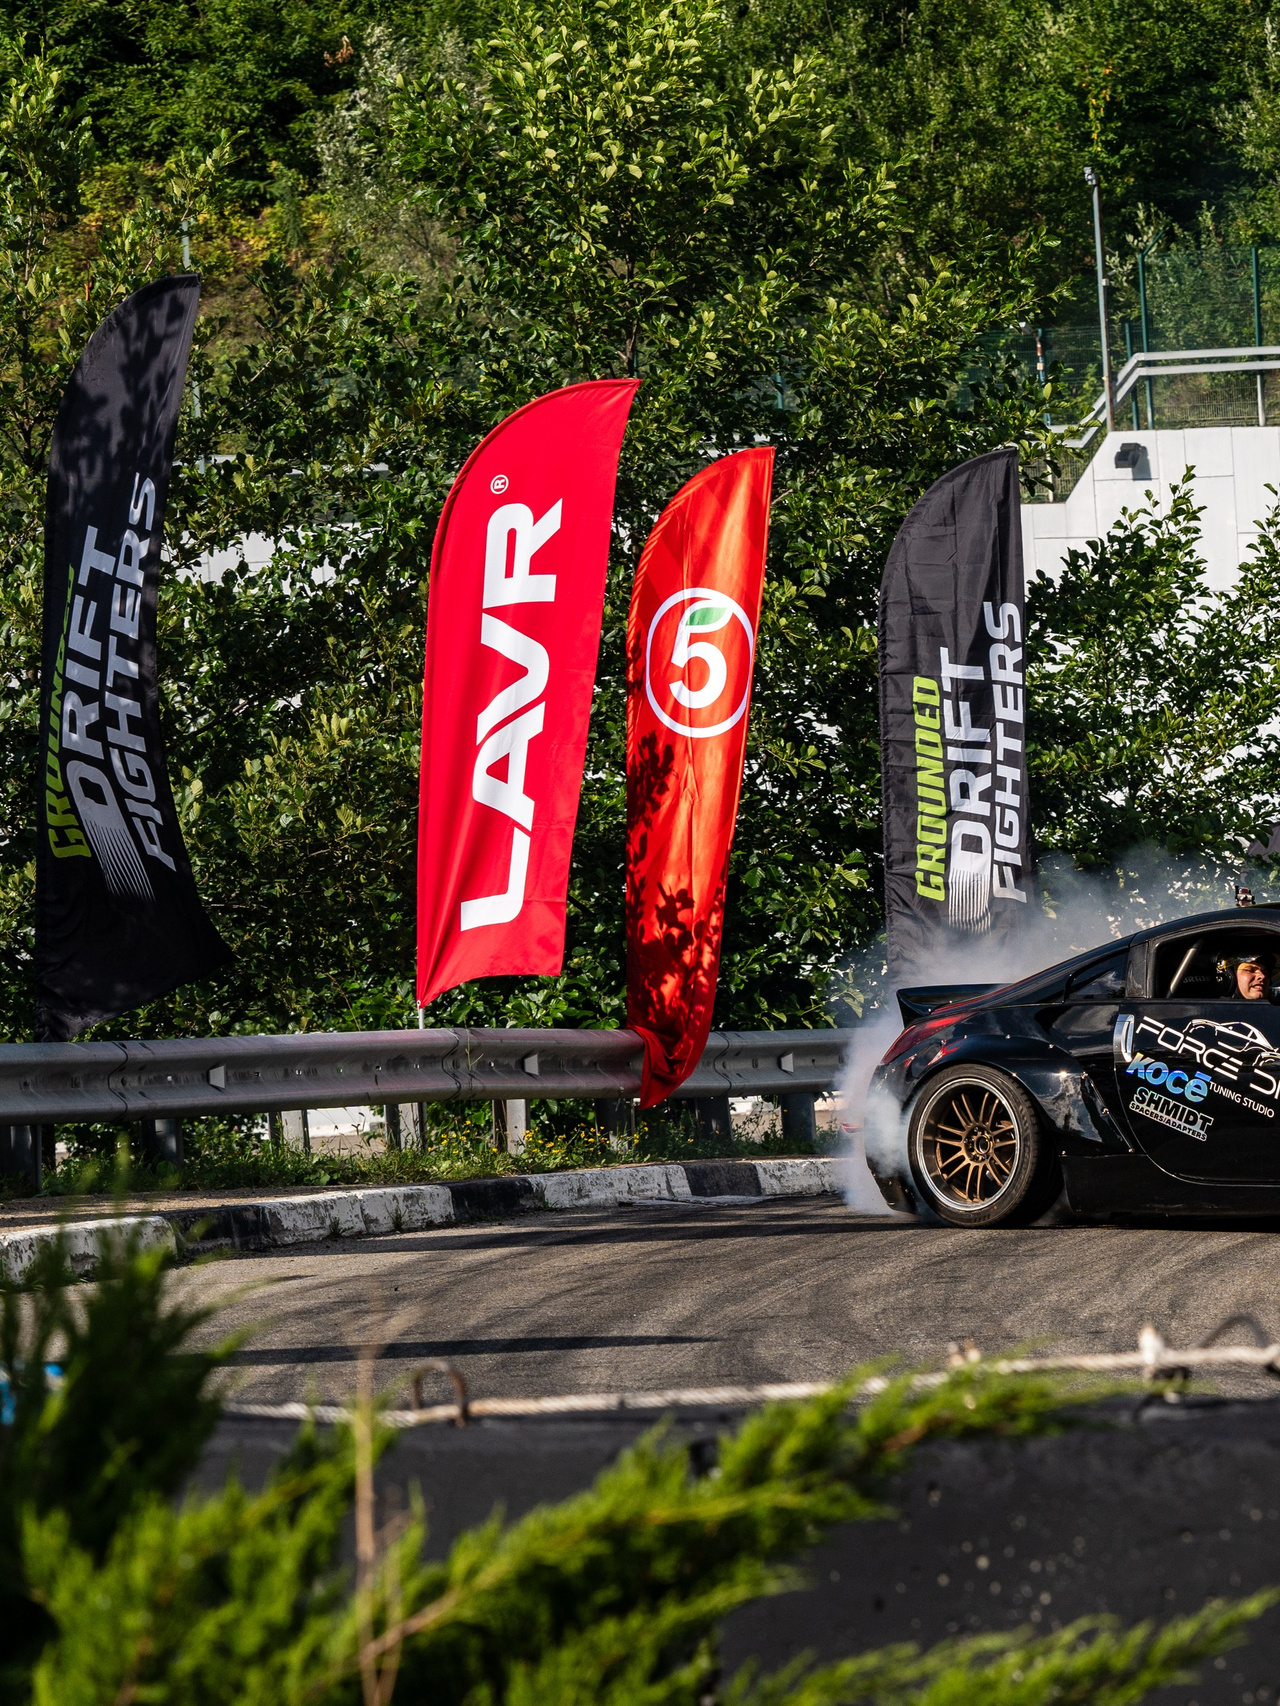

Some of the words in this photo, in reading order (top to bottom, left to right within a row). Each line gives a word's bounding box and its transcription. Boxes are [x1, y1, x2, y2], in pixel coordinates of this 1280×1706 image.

[46, 563, 92, 858] GROUND
[66, 526, 128, 860] DRIFT
[105, 472, 176, 872] FIGHTERS
[460, 498, 562, 932] LAVR
[912, 676, 947, 901] GROUNDED
[940, 646, 992, 884] DRIFT
[983, 601, 1027, 903] FIGHTERS
[1130, 1102, 1207, 1140] SPACERS/ADAPTERS
[1134, 1087, 1214, 1133] SHMIDT
[1136, 1016, 1243, 1081] FORCE
[1209, 1081, 1241, 1104] TUNING
[1242, 1098, 1275, 1118] STUDIO
